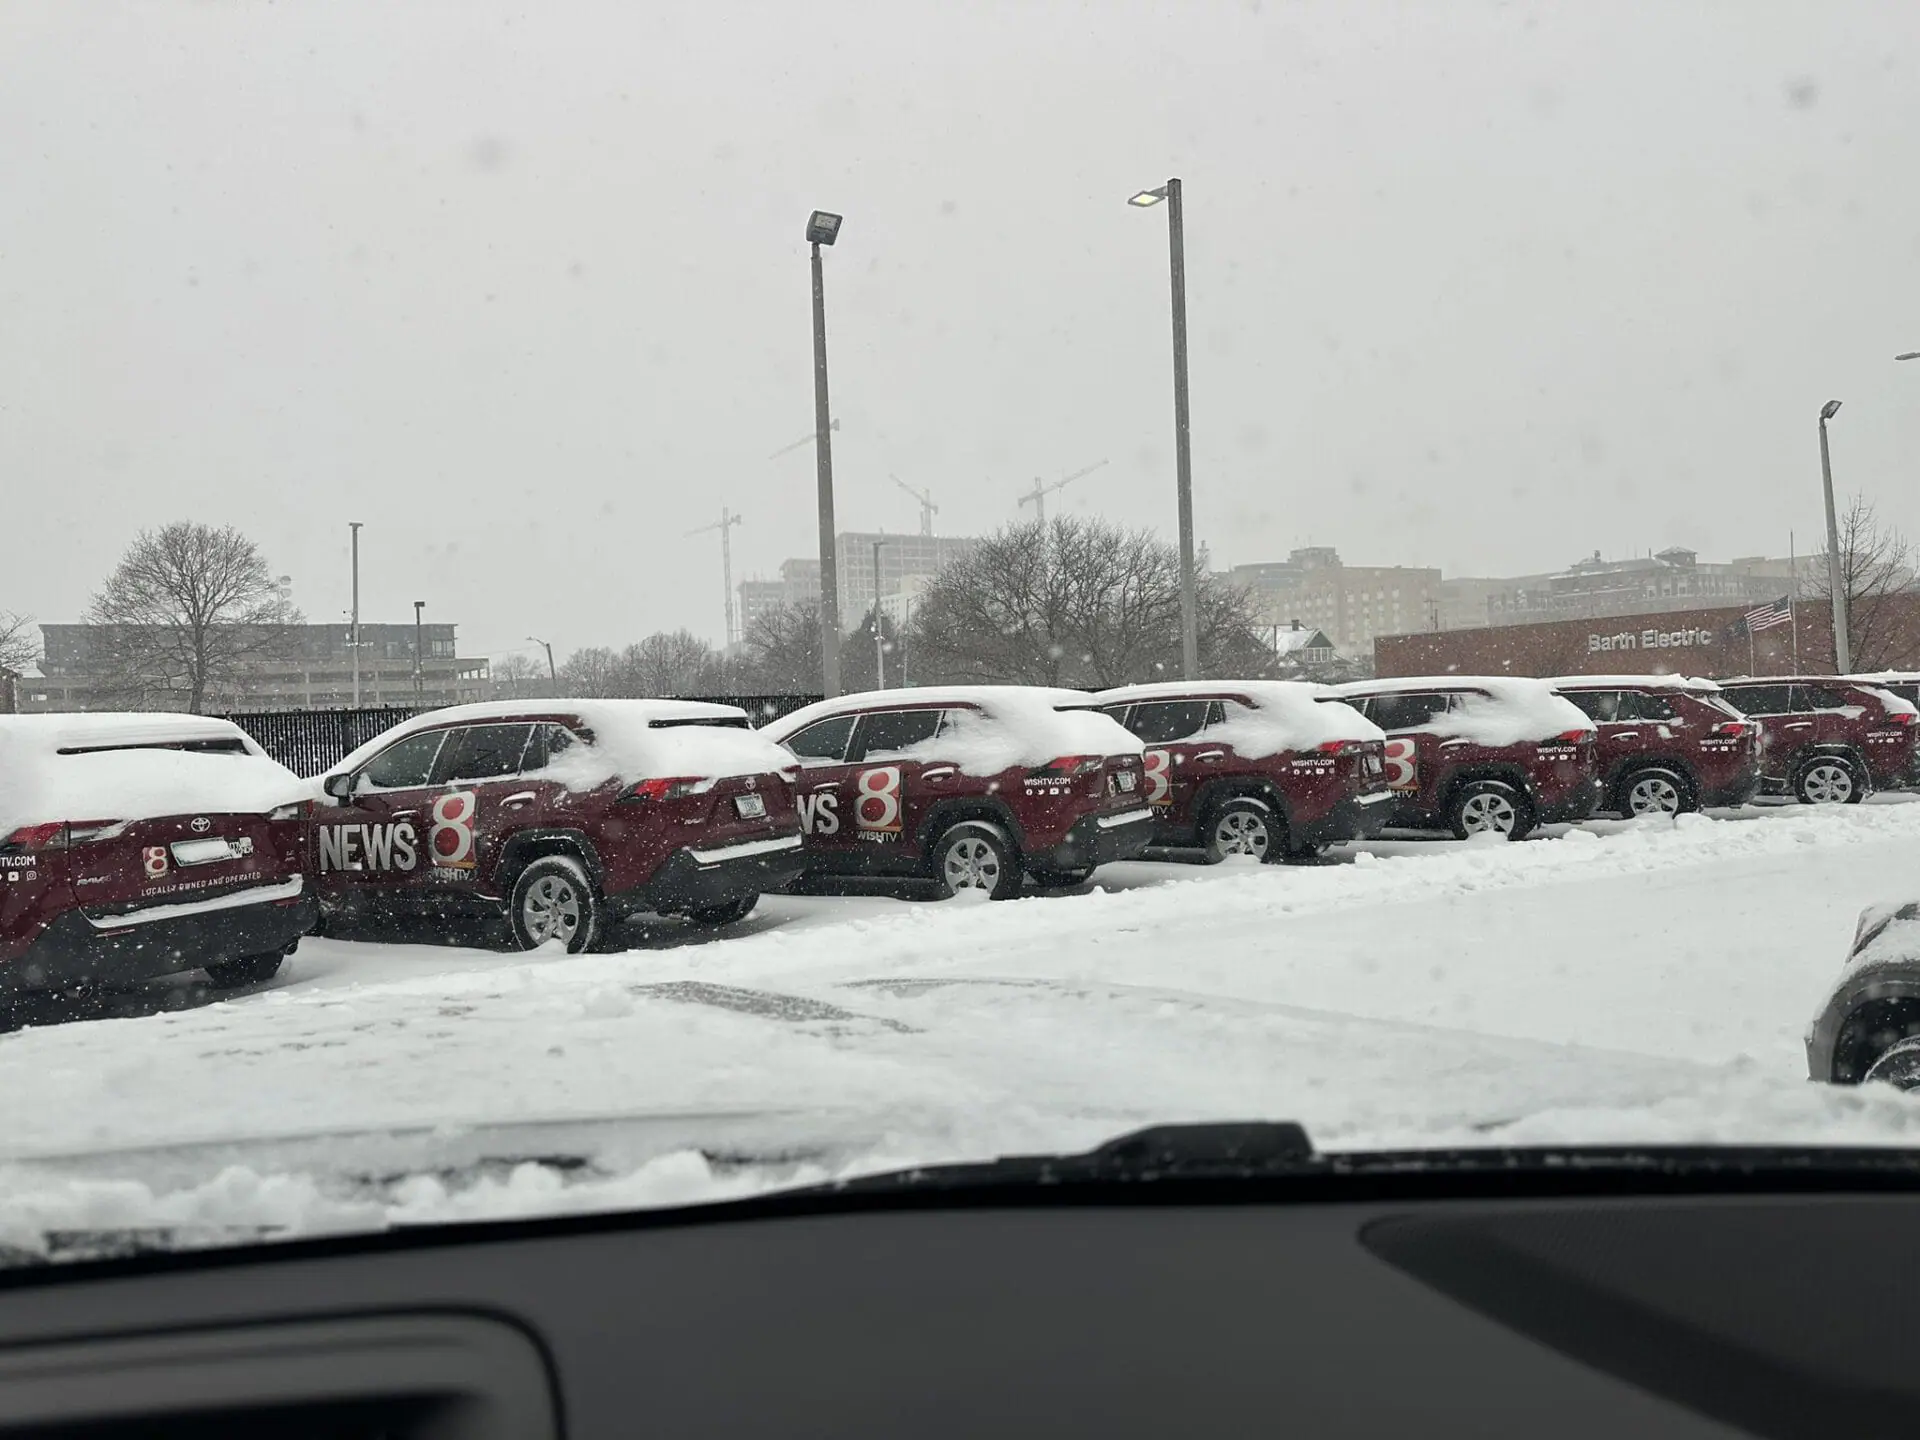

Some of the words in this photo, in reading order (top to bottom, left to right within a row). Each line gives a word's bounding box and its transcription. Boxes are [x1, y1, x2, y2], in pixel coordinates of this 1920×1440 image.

[1588, 632, 1636, 651] Barth
[1642, 628, 1711, 648] Electric
[1536, 746, 1577, 754] WISHTV.COM
[1290, 759, 1336, 767] WISHTV.COM
[1024, 777, 1071, 786] WISHTV.COM
[855, 766, 900, 828] 8
[319, 823, 417, 871] NEWS
[429, 790, 476, 863] 8
[857, 831, 898, 843] WISHTV
[0, 856, 36, 867] TV.COM
[146, 846, 169, 873] 8
[141, 884, 176, 897] LOCALLY
[179, 880, 206, 891] OWNED
[208, 876, 223, 886] AND
[225, 871, 261, 884] OPERATED
